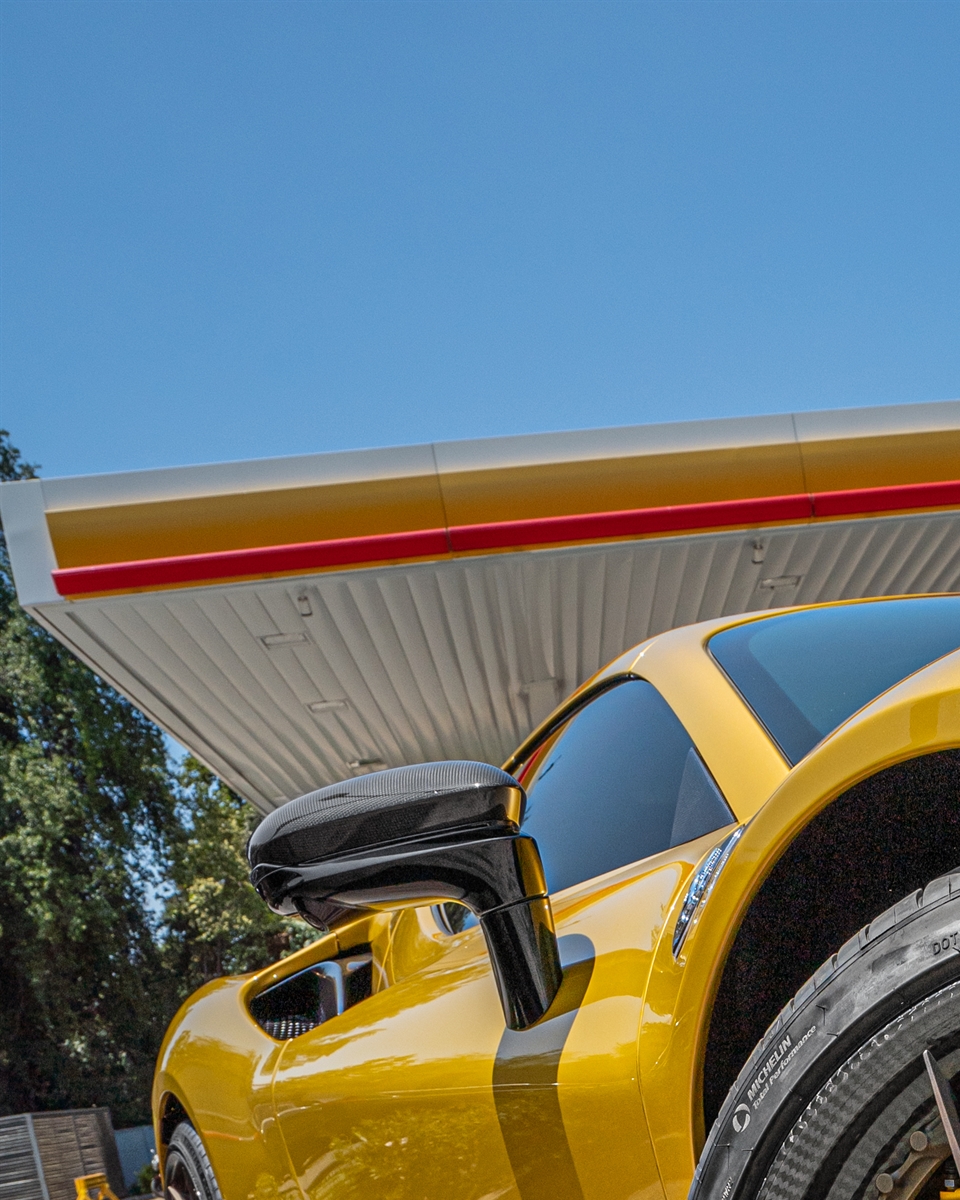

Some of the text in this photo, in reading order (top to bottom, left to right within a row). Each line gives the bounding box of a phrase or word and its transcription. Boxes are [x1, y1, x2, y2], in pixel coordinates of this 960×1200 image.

[933, 932, 958, 956] DOT
[747, 1035, 792, 1101] MICHELIN
[753, 1025, 816, 1110] Total Performance
